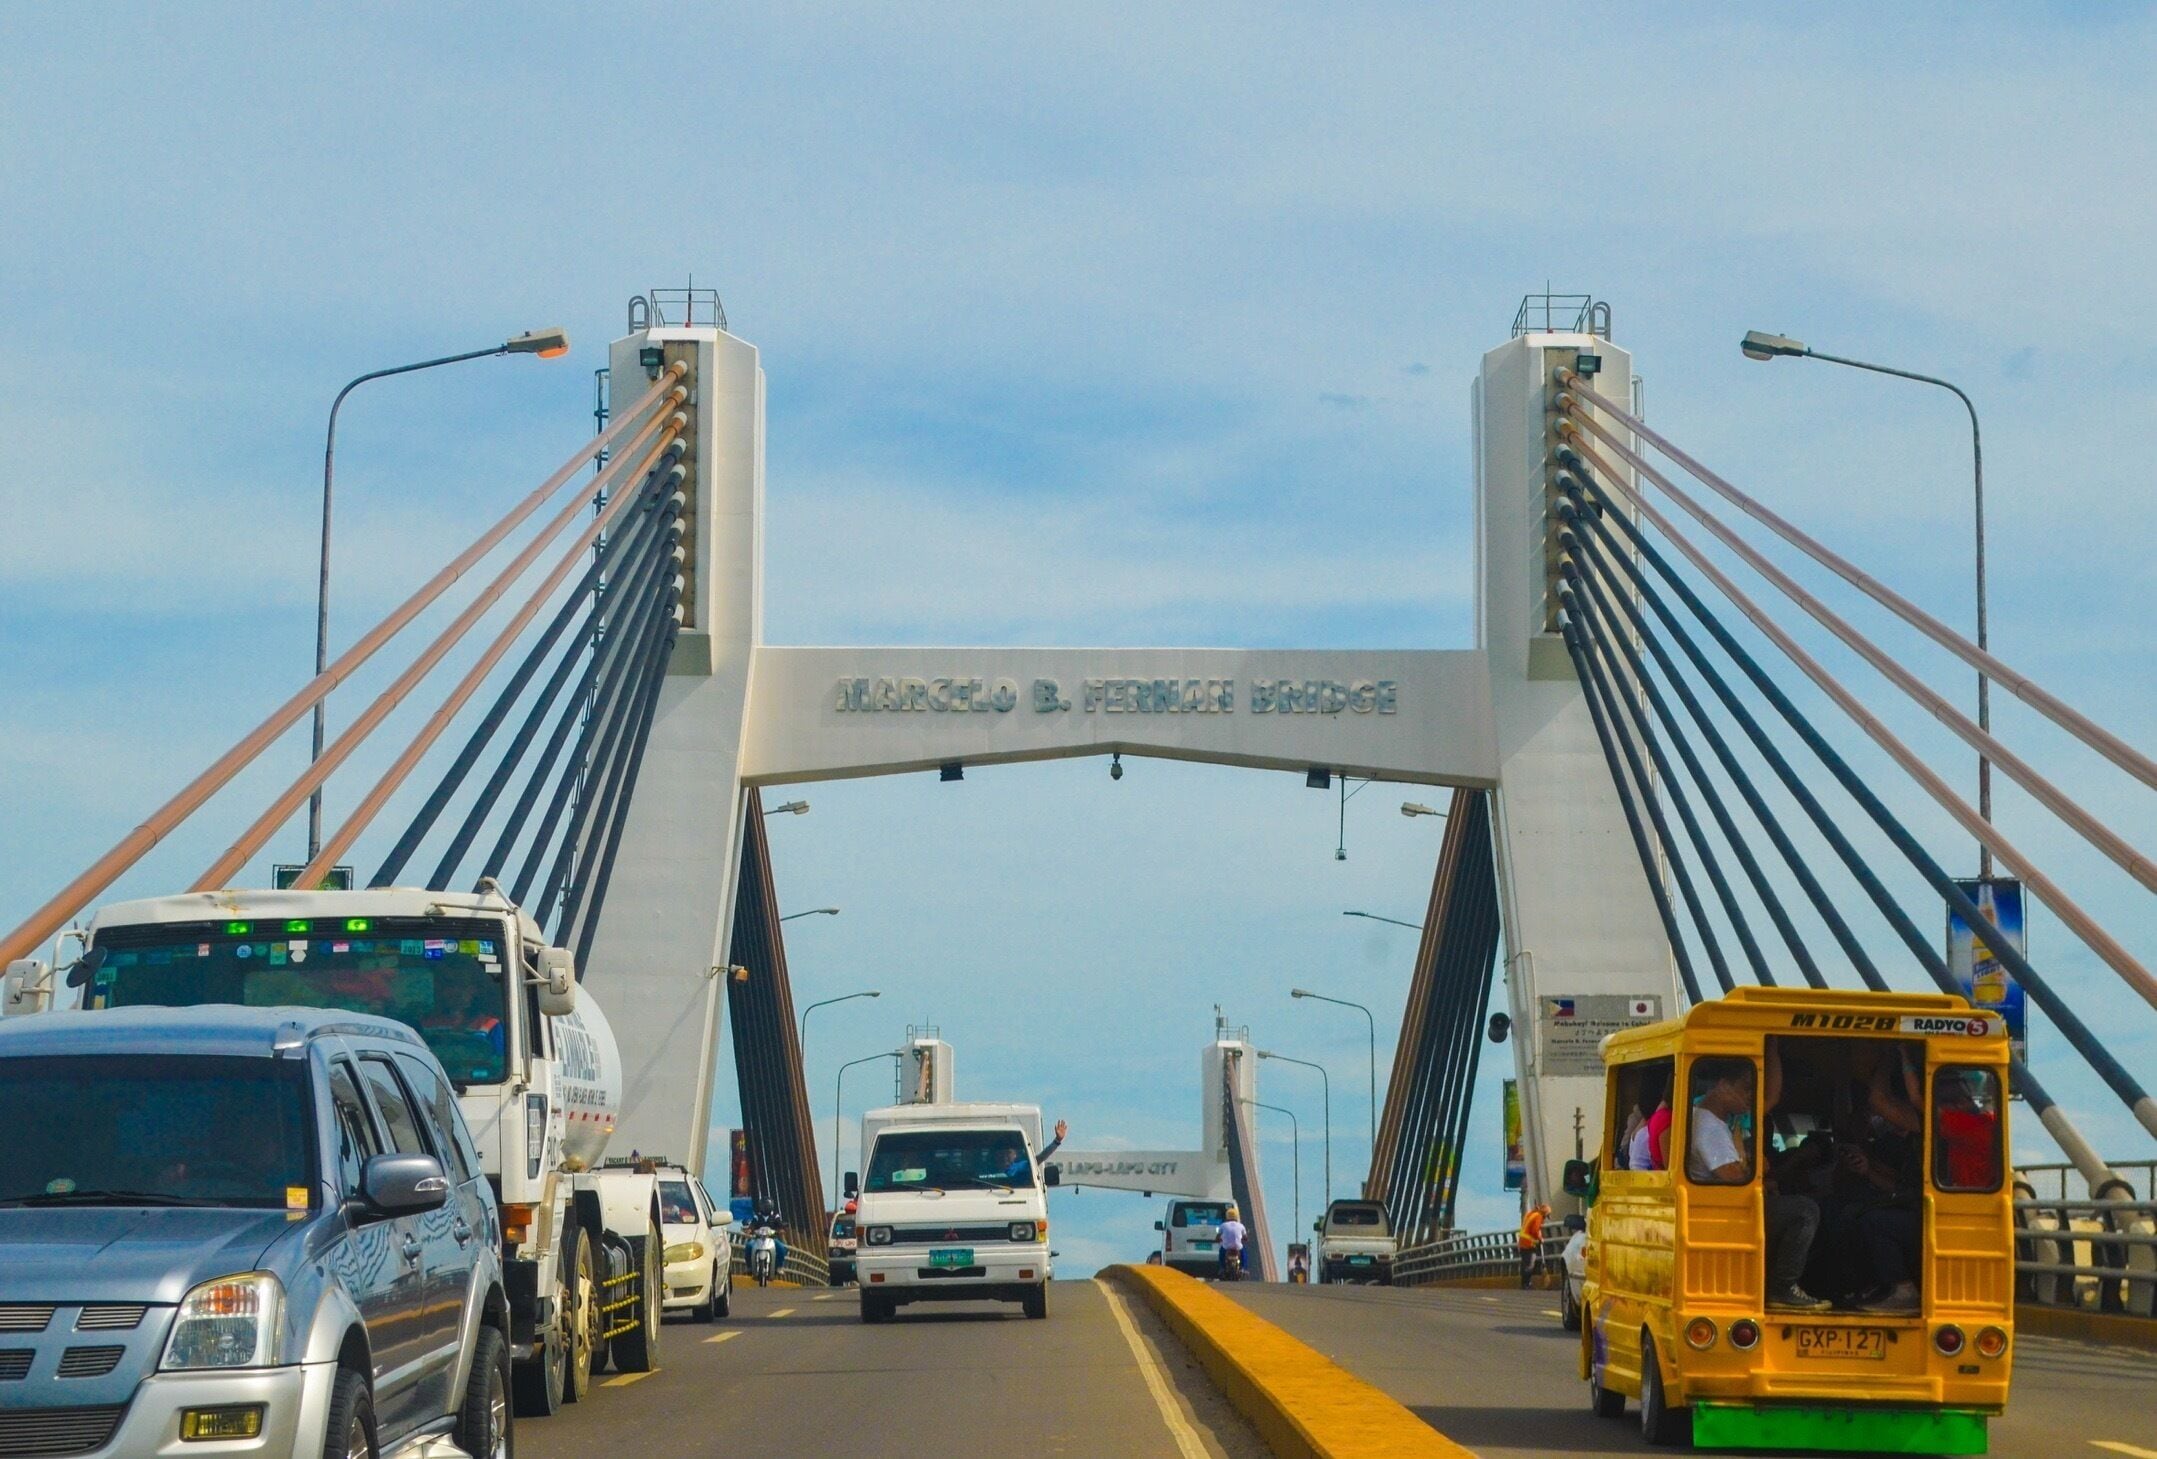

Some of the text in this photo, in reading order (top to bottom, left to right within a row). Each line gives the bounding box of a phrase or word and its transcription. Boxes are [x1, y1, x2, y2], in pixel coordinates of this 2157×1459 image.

[836, 677, 1398, 715] MARCELO B. FERNAN BRIDGE
[1914, 1018, 1966, 1031] RADYO
[1068, 1161, 1144, 1174] LAPU-LAPU
[1147, 1161, 1178, 1175] CITY
